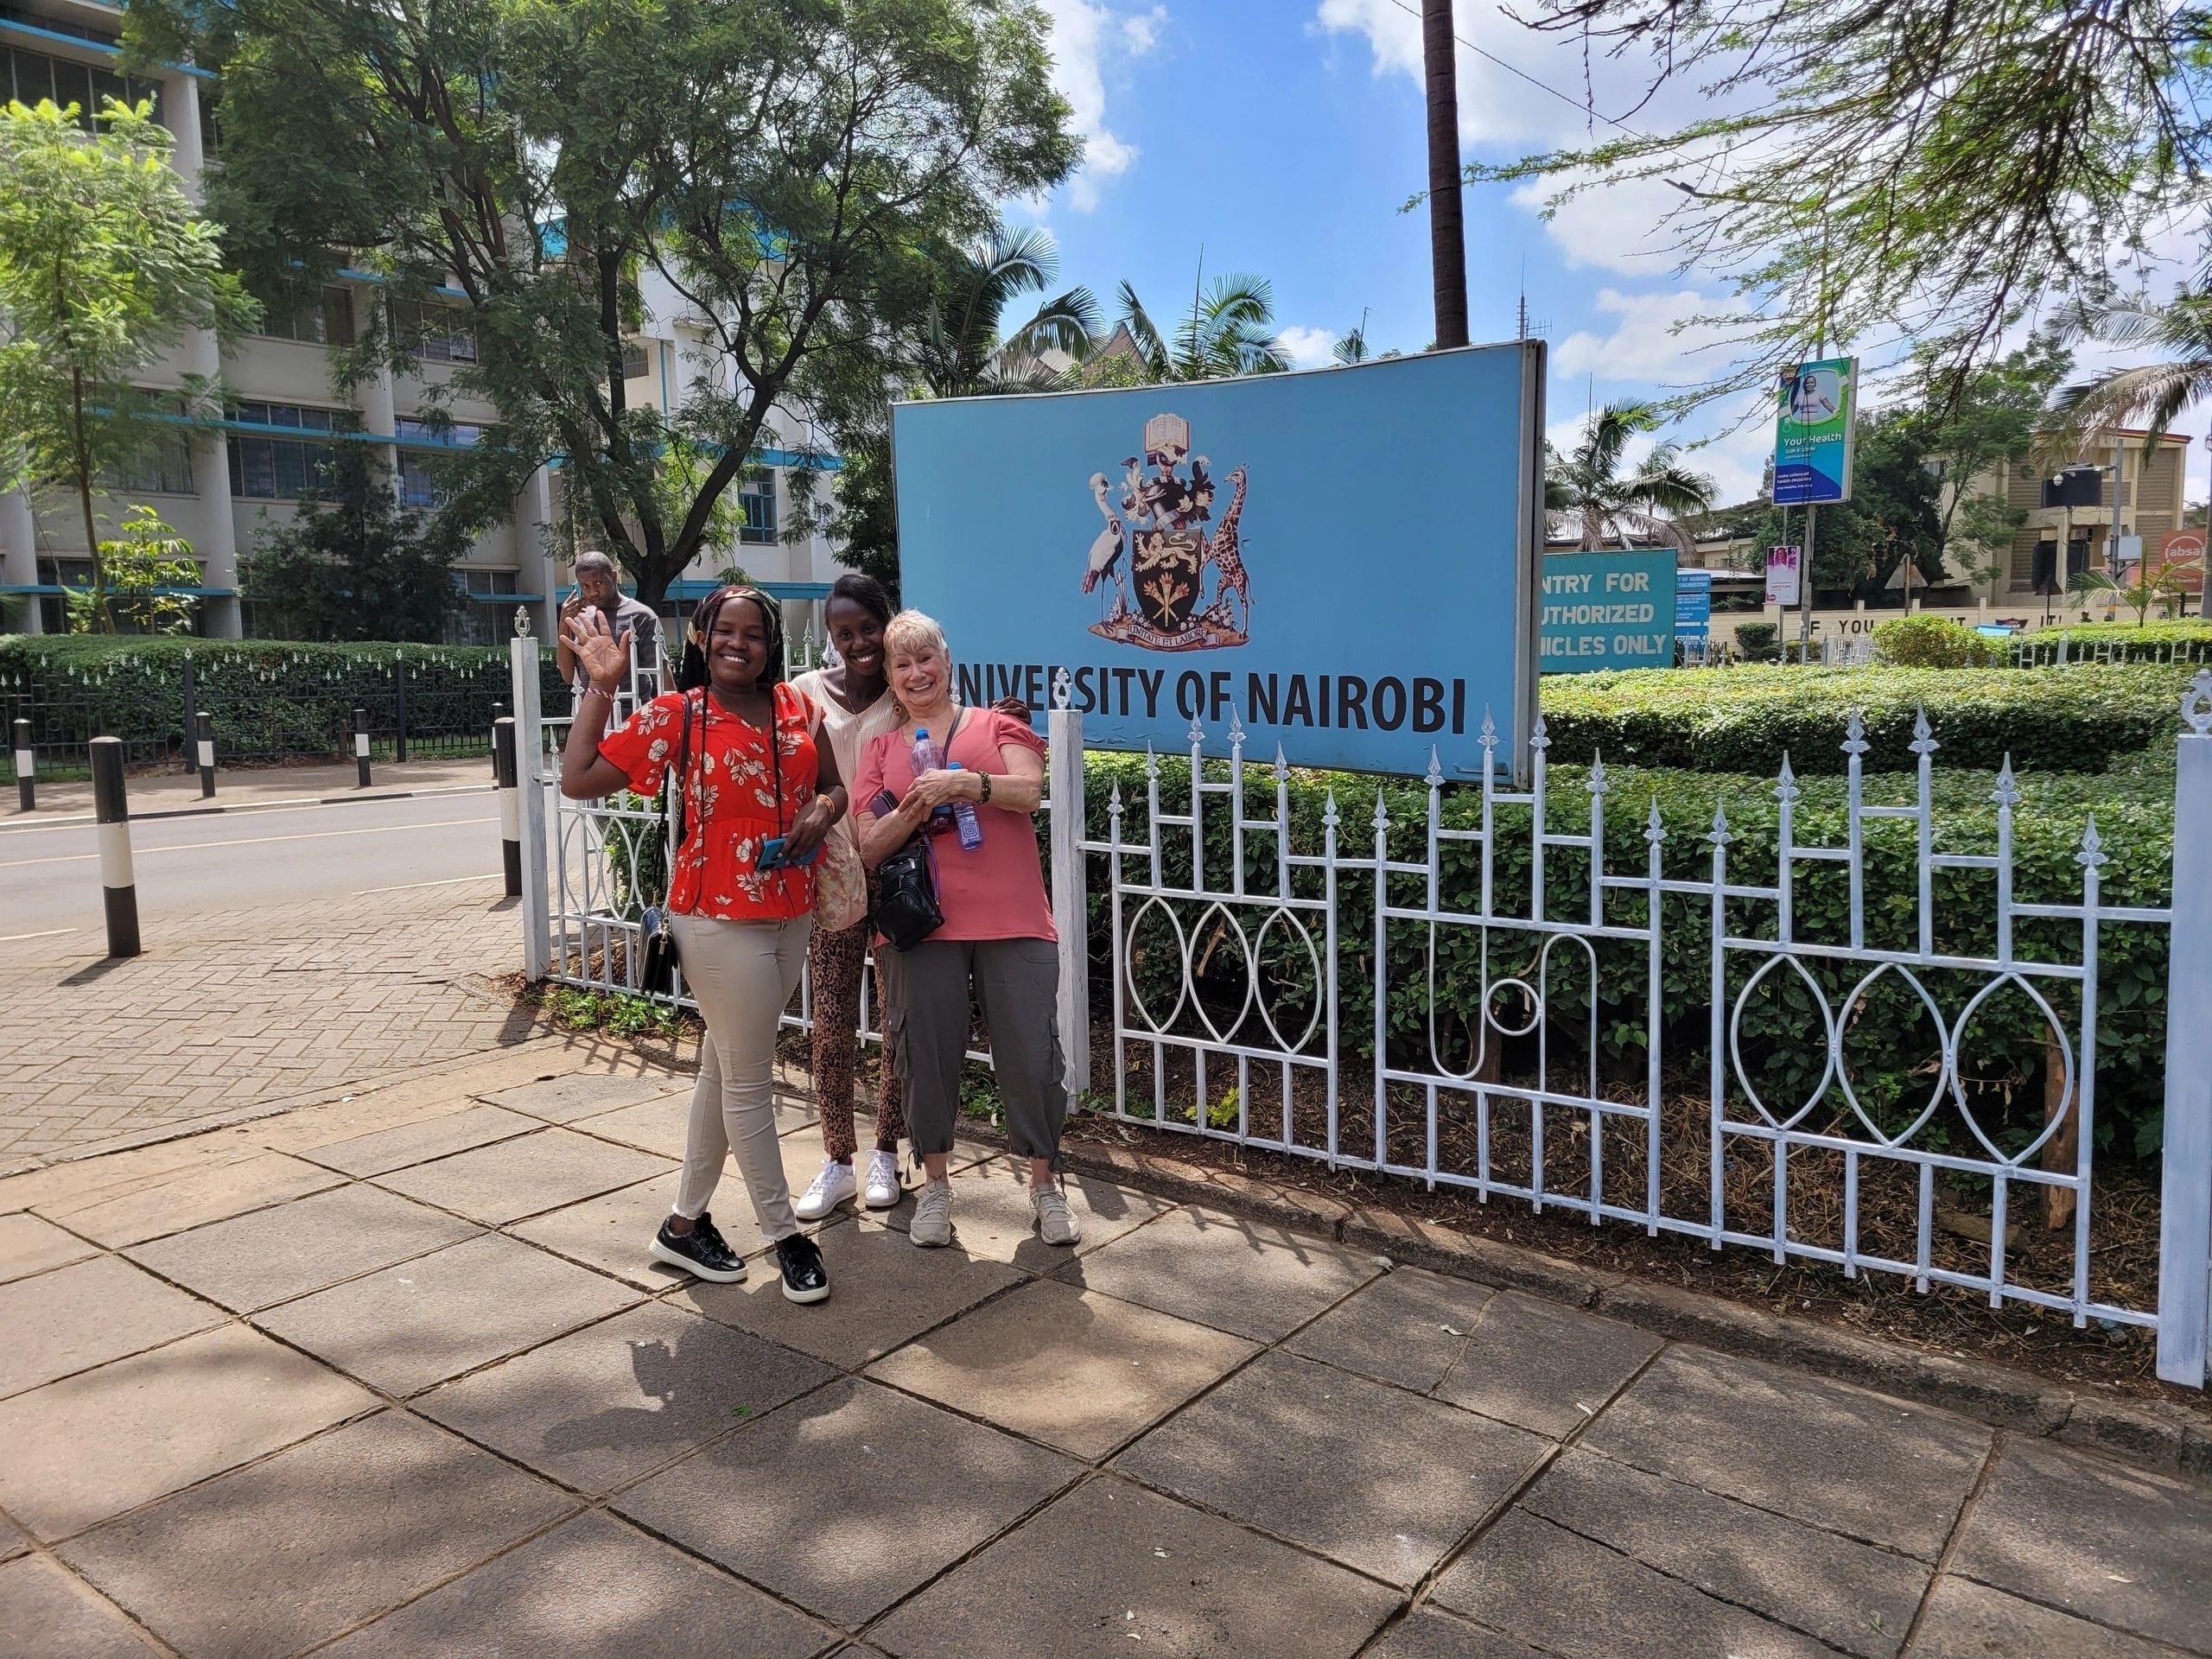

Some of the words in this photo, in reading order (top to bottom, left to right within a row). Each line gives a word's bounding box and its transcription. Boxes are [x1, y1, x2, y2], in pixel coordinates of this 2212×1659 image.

[1784, 437, 1807, 446] Your
[1809, 433, 1841, 443] Health
[2170, 546, 2200, 556] absa
[1542, 574, 1593, 594] NTRY
[1605, 572, 1649, 592] FOR
[1541, 604, 1654, 626] UTHORIZED
[1129, 626, 1160, 645] UNITATE
[1176, 628, 1206, 645] LABORE
[1839, 620, 1873, 634] YOU
[1613, 634, 1667, 655] ONLY
[951, 663, 1165, 719] NIVERSITY
[1176, 670, 1231, 722] OF
[1248, 671, 1465, 734] NAIROBI
